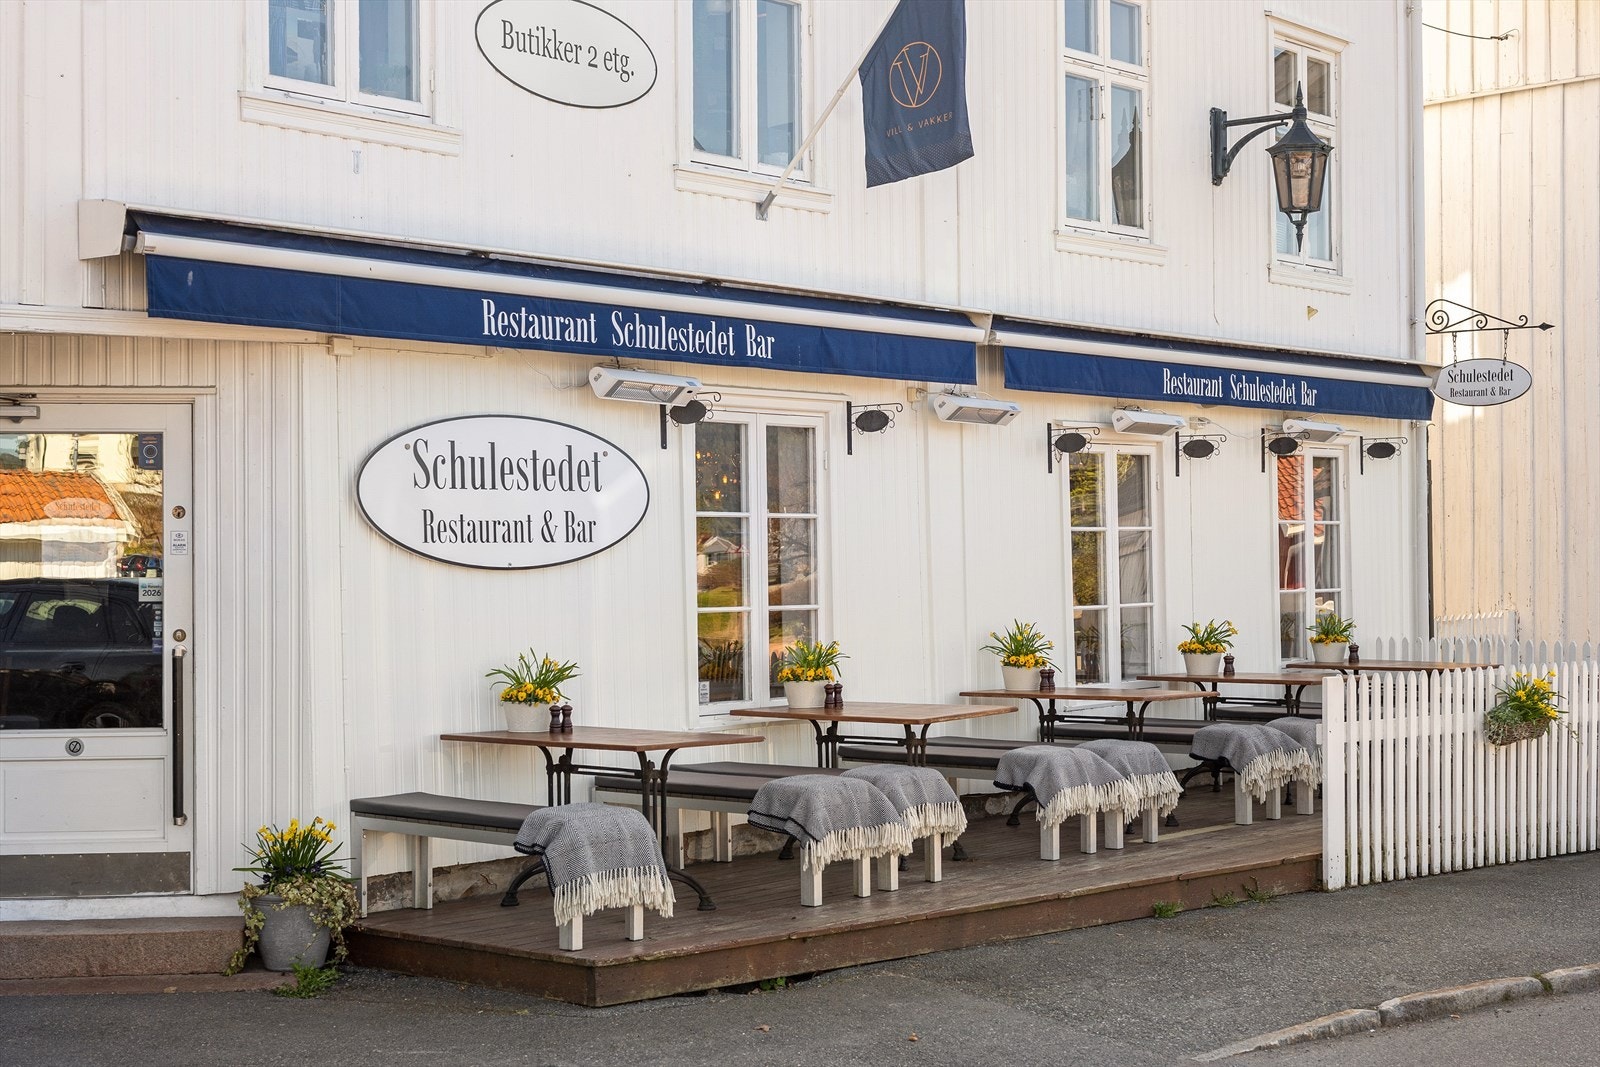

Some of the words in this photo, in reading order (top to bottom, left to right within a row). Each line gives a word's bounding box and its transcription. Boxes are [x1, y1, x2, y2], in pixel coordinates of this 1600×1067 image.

[501, 19, 583, 65] Butikker
[587, 45, 599, 69] 2
[603, 47, 635, 83] etg.
[886, 125, 903, 138] VILL
[906, 123, 914, 132] &
[918, 111, 953, 129] VAKKER
[481, 297, 598, 344] Restaurant
[611, 309, 736, 357] Schulestedet
[744, 323, 776, 360] Bar
[1162, 367, 1224, 398] Restaurant
[1230, 373, 1297, 406] Schulestedet
[1300, 380, 1318, 407] Bar
[1447, 367, 1514, 384] Schulestedet
[1449, 387, 1488, 398] Restaurant
[1490, 386, 1497, 397] &
[1498, 386, 1511, 396] Bar
[412, 438, 603, 493] Schulestedet
[421, 508, 534, 544] Restaurant
[541, 509, 558, 543] &
[563, 510, 597, 543] Bar
[142, 589, 162, 597] 2026
